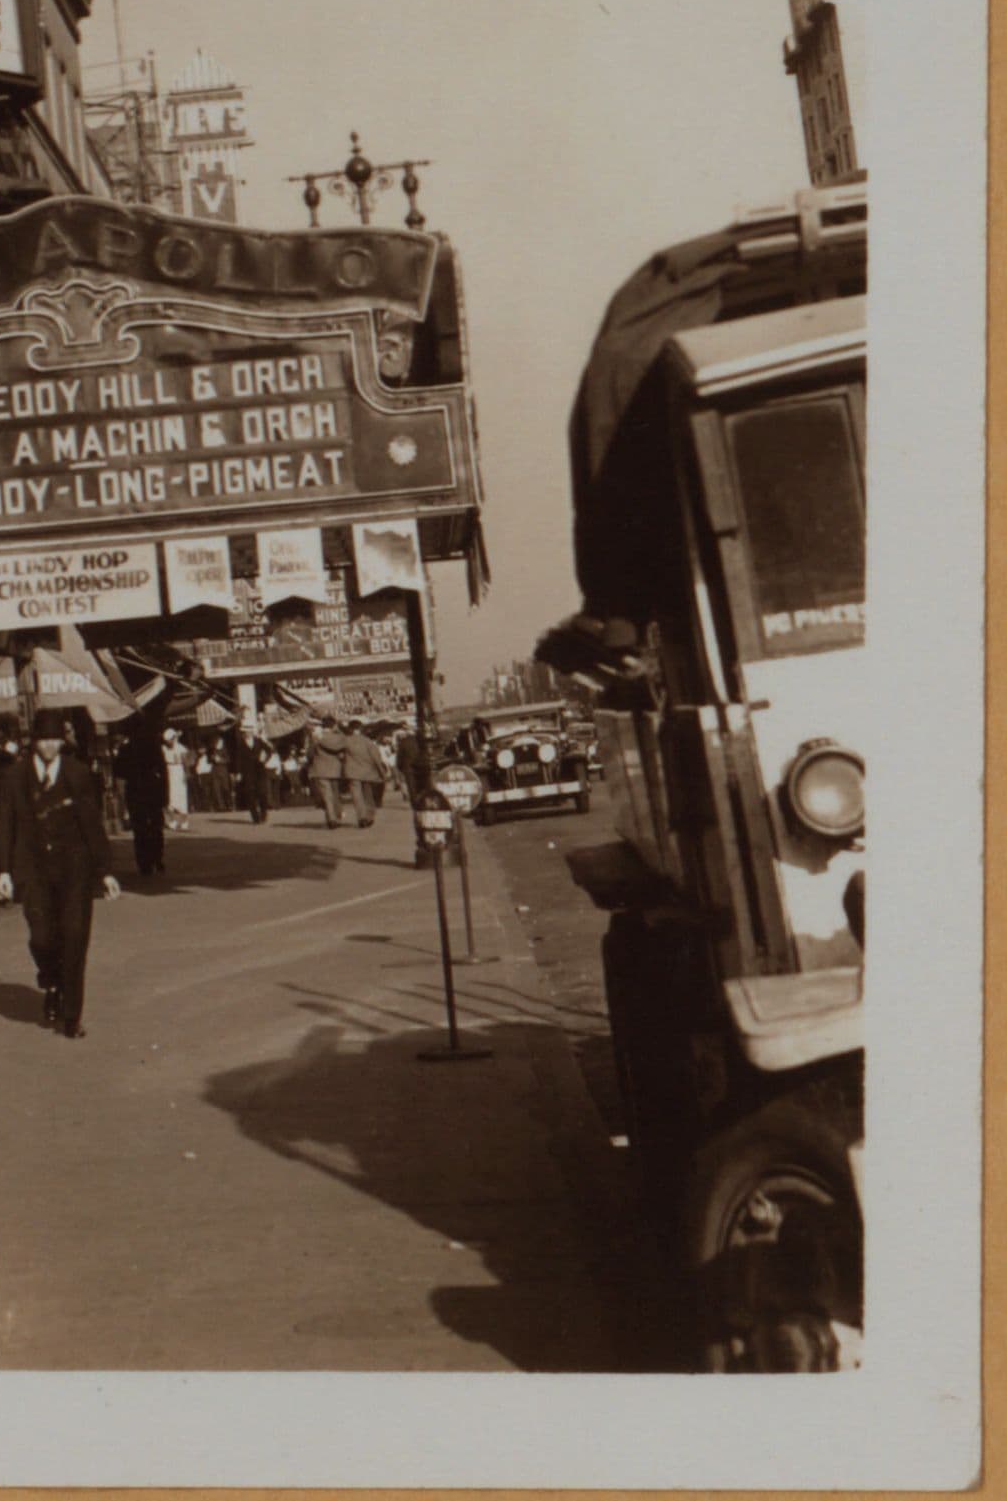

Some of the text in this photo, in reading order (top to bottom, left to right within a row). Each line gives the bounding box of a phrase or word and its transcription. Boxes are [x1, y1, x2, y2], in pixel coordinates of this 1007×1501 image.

[32, 219, 377, 299] APOLLO
[98, 370, 178, 410] HILL
[192, 365, 218, 402] &
[231, 355, 325, 397] ORCH
[200, 412, 227, 449] &
[241, 402, 338, 445] ORCH
[14, 549, 130, 577] LINDY HOP
[18, 594, 100, 619] CONTEST
[320, 619, 405, 642] CHEATERS
